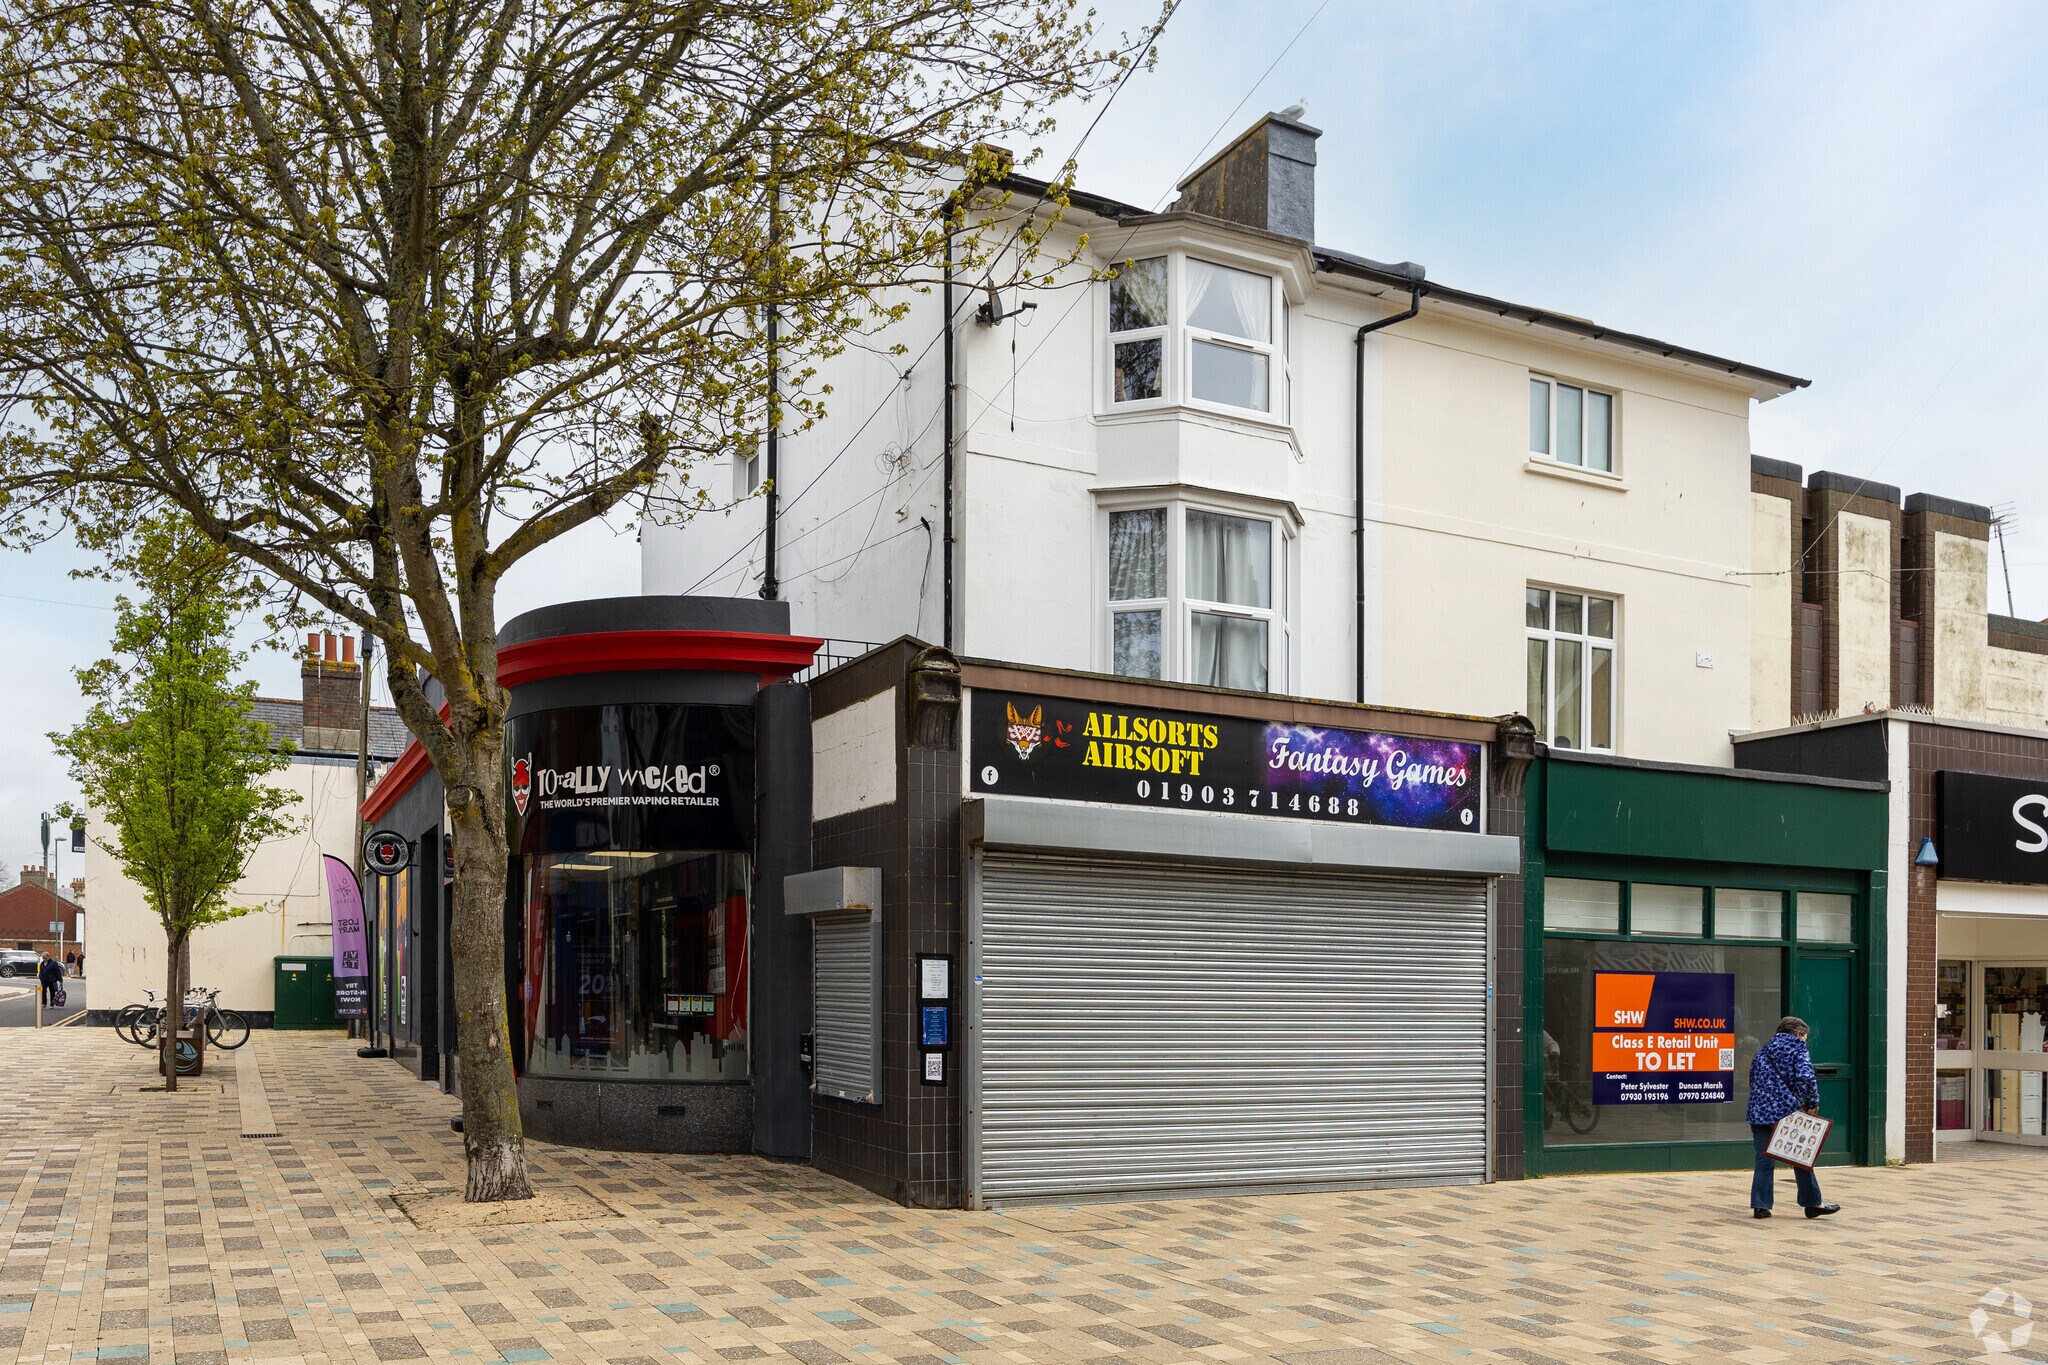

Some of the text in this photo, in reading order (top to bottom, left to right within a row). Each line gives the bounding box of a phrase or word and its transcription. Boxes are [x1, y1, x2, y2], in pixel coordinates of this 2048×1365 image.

[1083, 712, 1219, 749] ALLSORTS
[1082, 740, 1204, 776] AIRSOFT
[1268, 737, 1467, 791] Fantasy Games
[540, 796, 720, 810] THE WORLD'S PREMIER VAPING RETAILER
[1136, 779, 1359, 816] 01903 714688
[1614, 1010, 1644, 1024] SHW
[1674, 1018, 1726, 1029] SHW.CO.UK
[1611, 1034, 1719, 1049] Class E Retail Unit
[1635, 1052, 1696, 1071] TO LET
[1620, 1082, 1669, 1091] Peter Sylvester
[1703, 1081, 1723, 1089] Marsh
[1620, 1093, 1669, 1101] 07930 195196
[1678, 1092, 1725, 1100] 07970 524840
